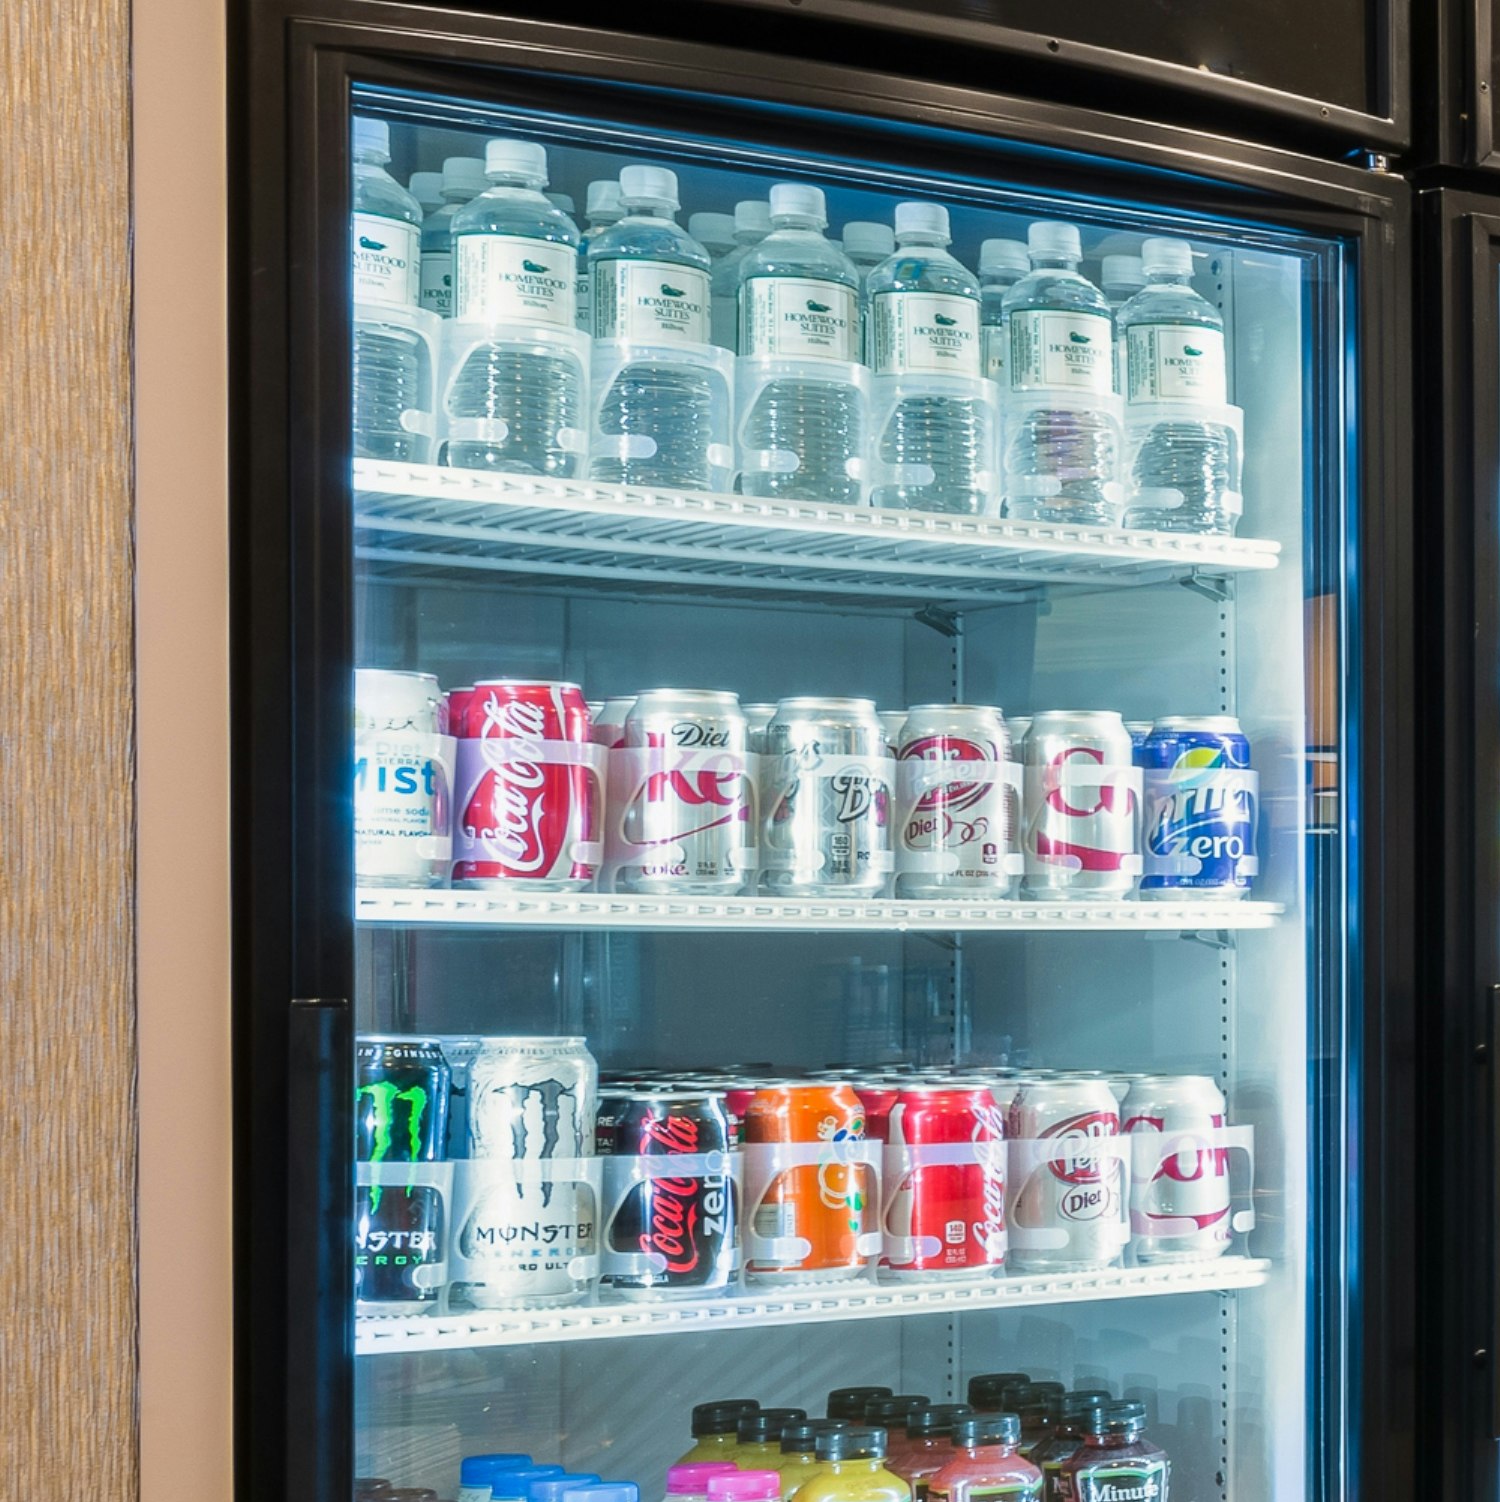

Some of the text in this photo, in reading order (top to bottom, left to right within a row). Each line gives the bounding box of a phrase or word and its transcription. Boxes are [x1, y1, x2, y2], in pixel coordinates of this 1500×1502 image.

[638, 297, 701, 314] HOMEWOOD
[654, 308, 691, 319] SUITES
[784, 313, 846, 328] HOMEWOOD
[671, 723, 731, 746] Diet
[477, 1221, 593, 1245] MONSTER
[1091, 1483, 1160, 1502] Minute
